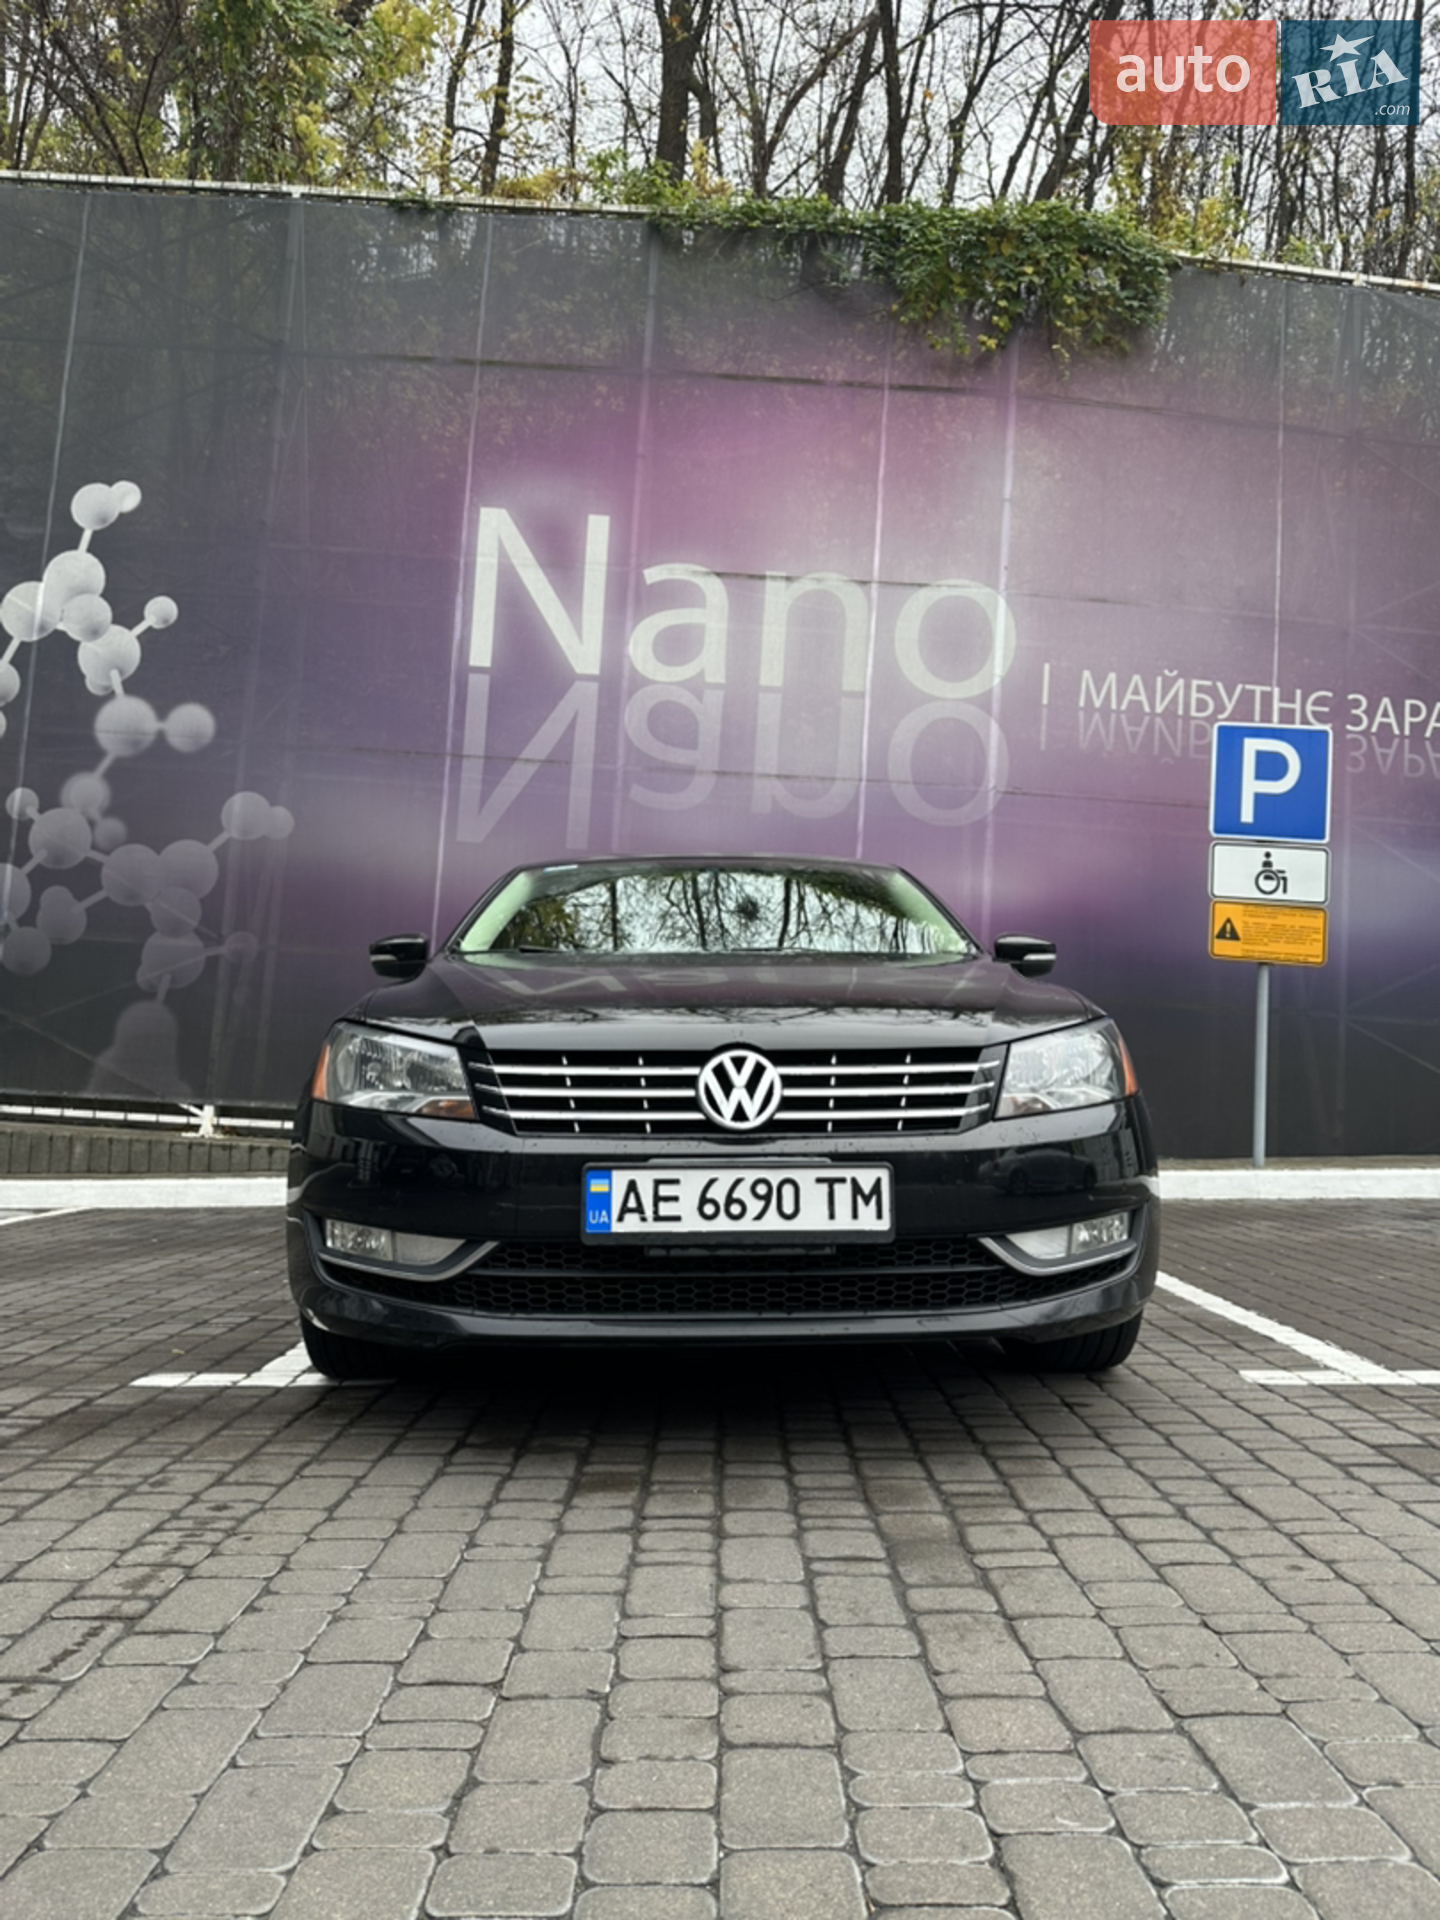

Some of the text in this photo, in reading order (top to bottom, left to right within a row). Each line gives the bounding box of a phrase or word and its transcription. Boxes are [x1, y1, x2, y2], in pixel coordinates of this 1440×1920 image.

[468, 506, 1017, 700] Nano
[1078, 669, 1333, 729] МАЙБУТНЄ
[1240, 737, 1302, 824] P
[589, 1210, 609, 1224] UA
[616, 1176, 882, 1222] AE 6690 TM
